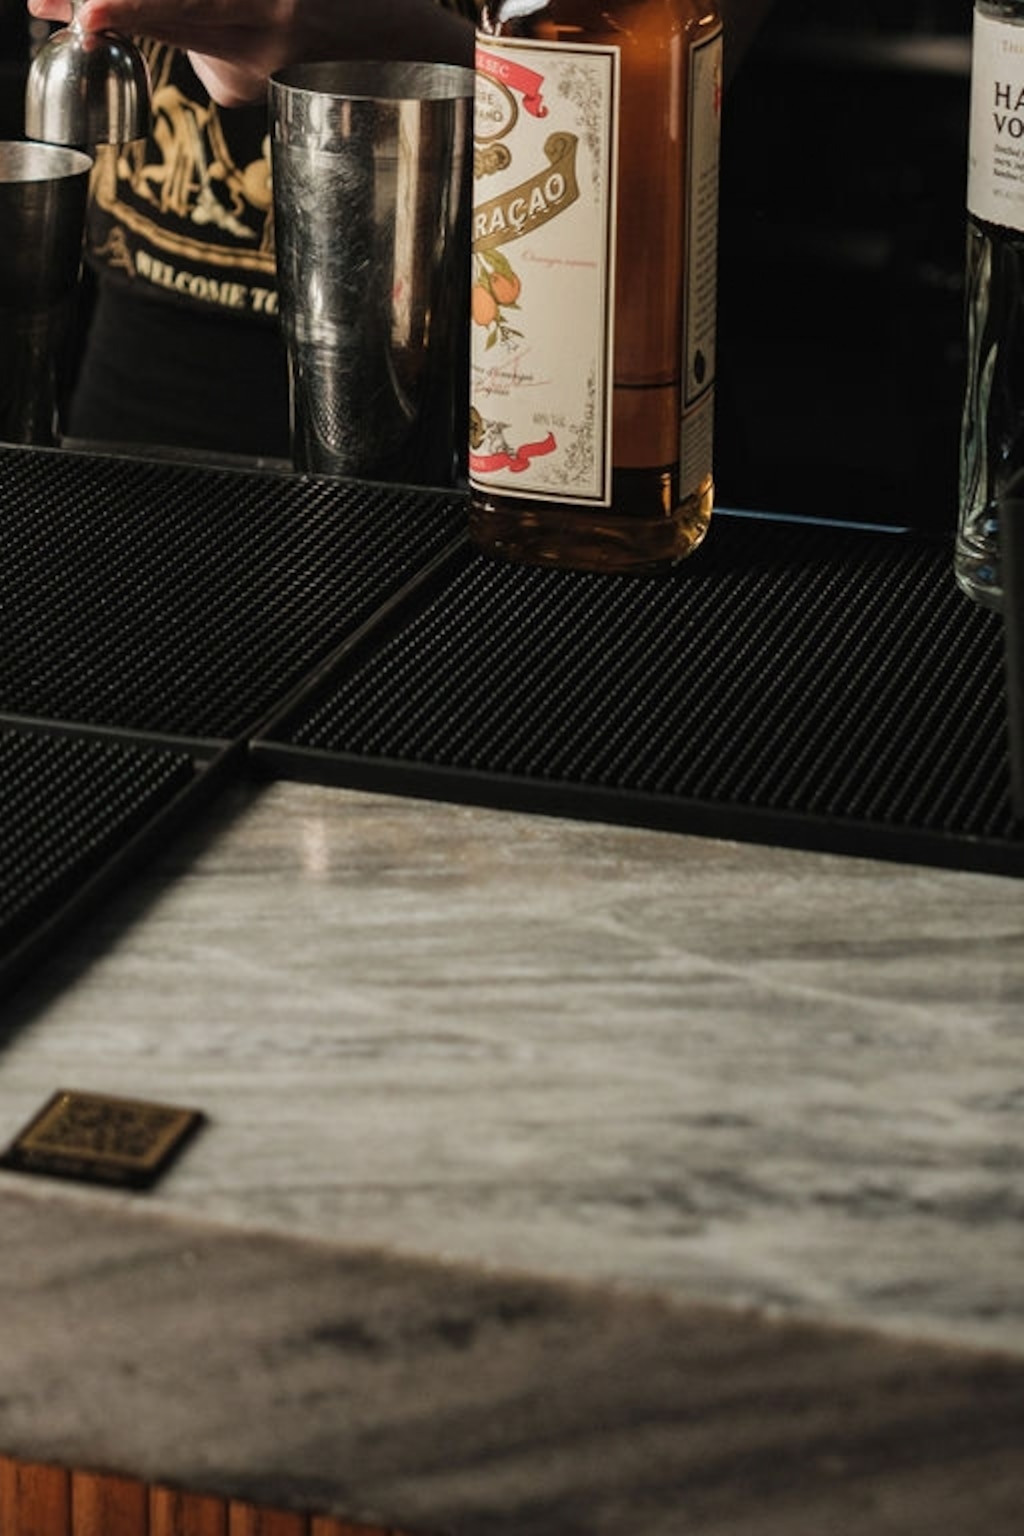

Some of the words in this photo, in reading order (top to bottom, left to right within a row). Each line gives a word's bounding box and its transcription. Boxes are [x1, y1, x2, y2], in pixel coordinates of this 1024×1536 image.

[993, 112, 1024, 139] VO
[474, 173, 567, 240] RAÇAO
[136, 250, 247, 309] WELCOME
